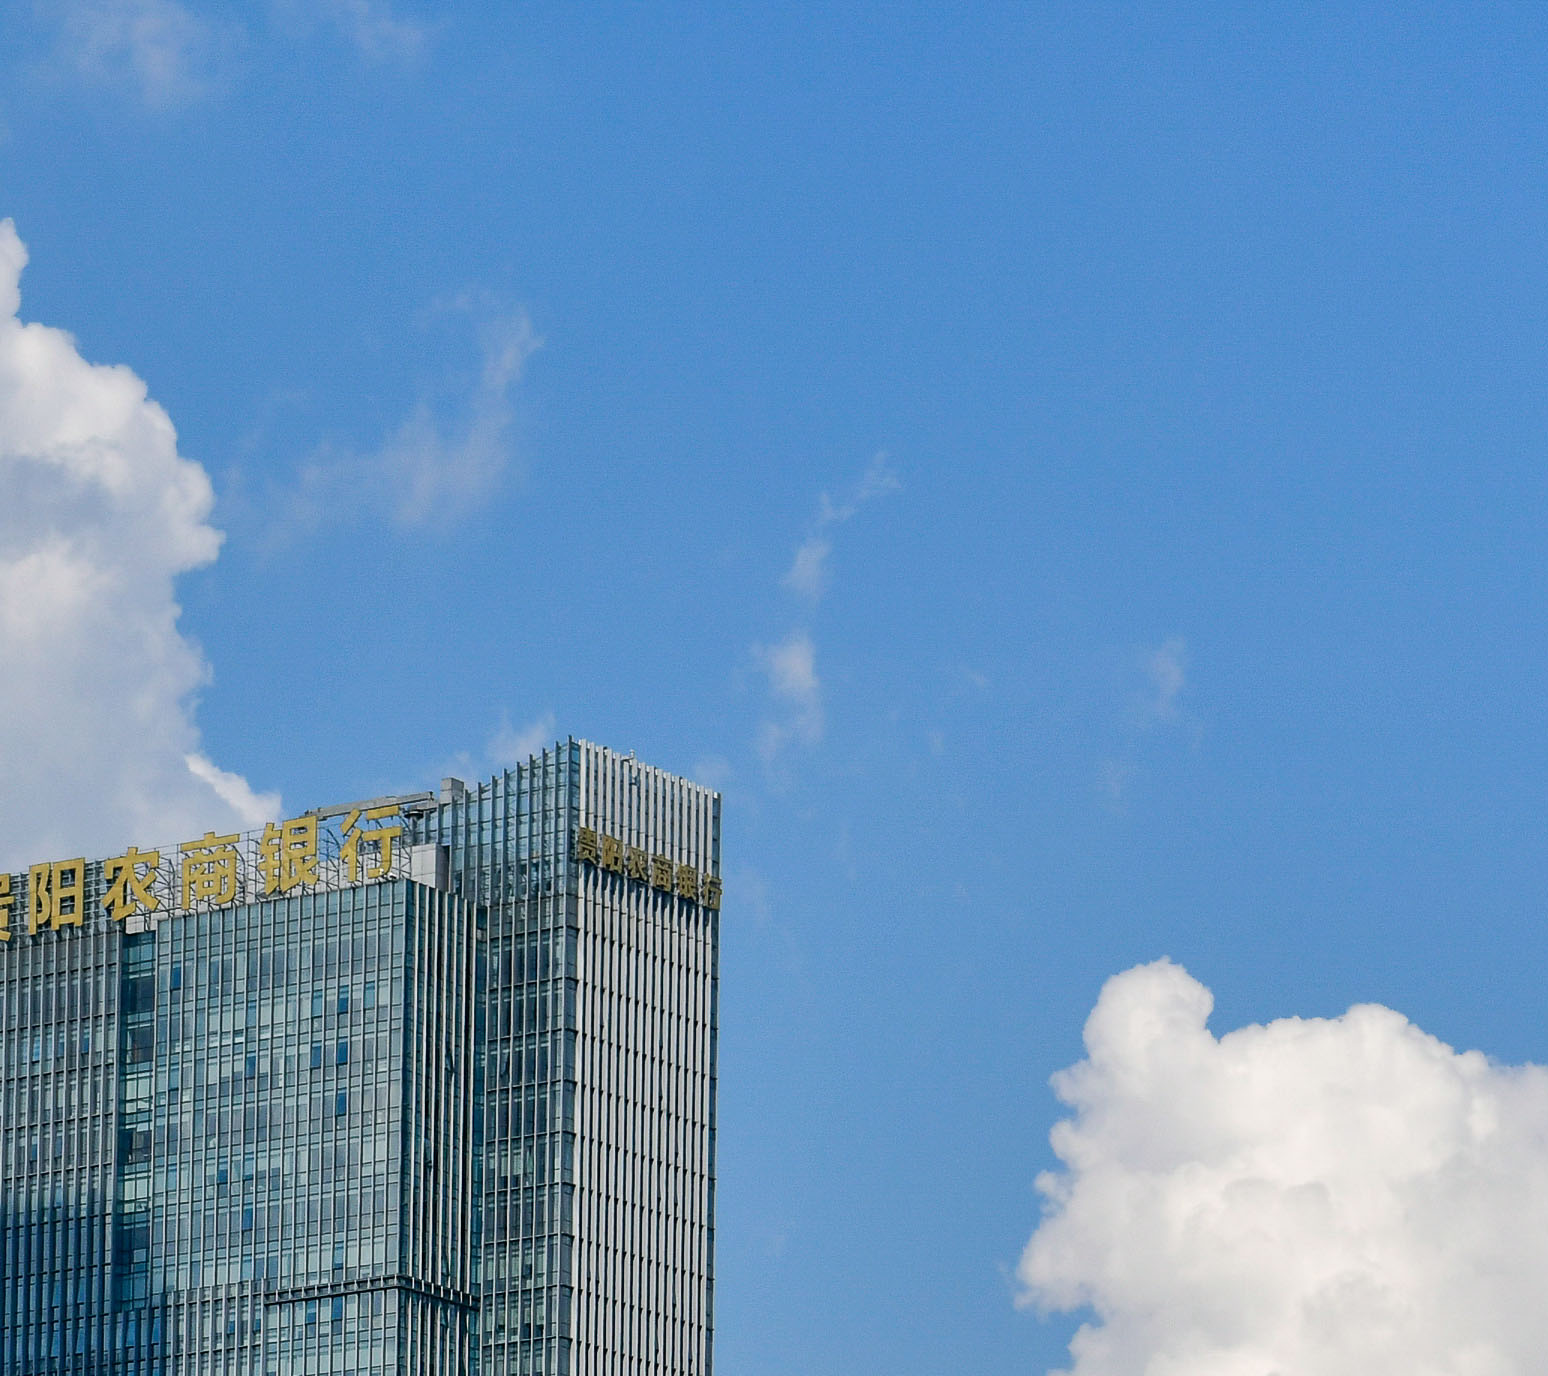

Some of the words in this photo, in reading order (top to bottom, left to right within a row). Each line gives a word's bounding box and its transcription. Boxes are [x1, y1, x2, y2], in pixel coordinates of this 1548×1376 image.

[578, 826, 722, 911] 贵阳农商银行
